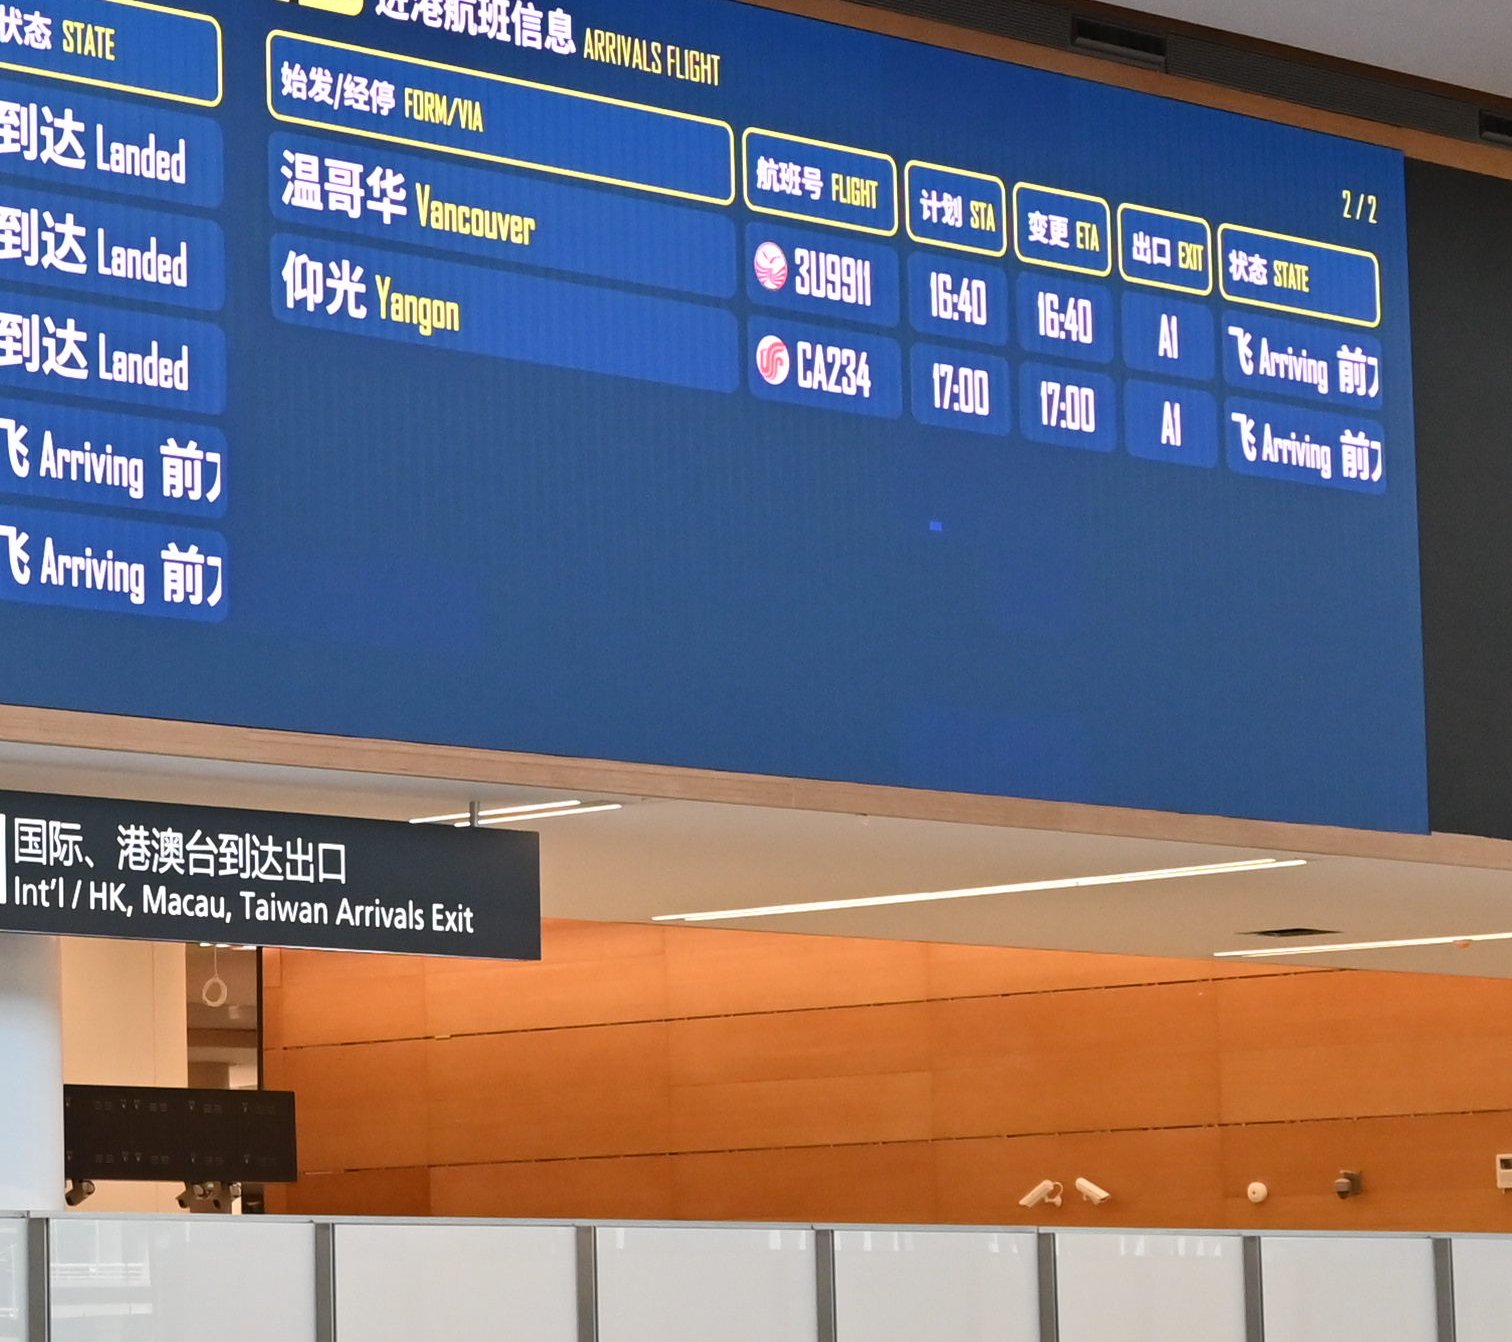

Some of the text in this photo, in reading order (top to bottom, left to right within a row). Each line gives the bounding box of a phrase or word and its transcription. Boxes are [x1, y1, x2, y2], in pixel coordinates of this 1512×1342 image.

[62, 19, 116, 61] STATE
[583, 27, 662, 75] ARRIVALS
[666, 44, 721, 86] FLIGHT
[96, 123, 186, 185] Landed
[756, 155, 879, 209] 航班号 FLIGHT
[280, 149, 536, 246] 温哥华 Vancouver
[919, 188, 996, 232] 计划 STA
[97, 227, 188, 288] Landed
[1027, 210, 1100, 252] 变更 ETA
[1132, 231, 1204, 272] 出口 EXIT
[281, 250, 460, 337] 仰光 Yangon
[794, 247, 872, 307] 3U9911
[929, 271, 987, 326] 16:40
[1228, 249, 1310, 293] 状态 STATE
[1037, 291, 1093, 344] 16:40
[1158, 313, 1179, 359] A1
[98, 332, 189, 392] Landed
[796, 340, 872, 398] CA234
[1227, 325, 1254, 376] 飞
[1258, 337, 1329, 395] Arriving
[932, 362, 990, 416] 17:00
[1040, 380, 1096, 433] 17:00
[1160, 400, 1182, 447] A1
[1231, 412, 1257, 462] 飞
[1261, 422, 1332, 480] Arriving
[39, 430, 144, 499] Arriving
[40, 536, 145, 605] Arriving
[14, 817, 346, 884] 国际、港澳台到达出口
[89, 880, 134, 918] HK,
[142, 884, 232, 924] Macau,
[239, 890, 328, 925] Taiwan
[335, 897, 425, 931] Arrivals
[432, 903, 475, 934] Exit
